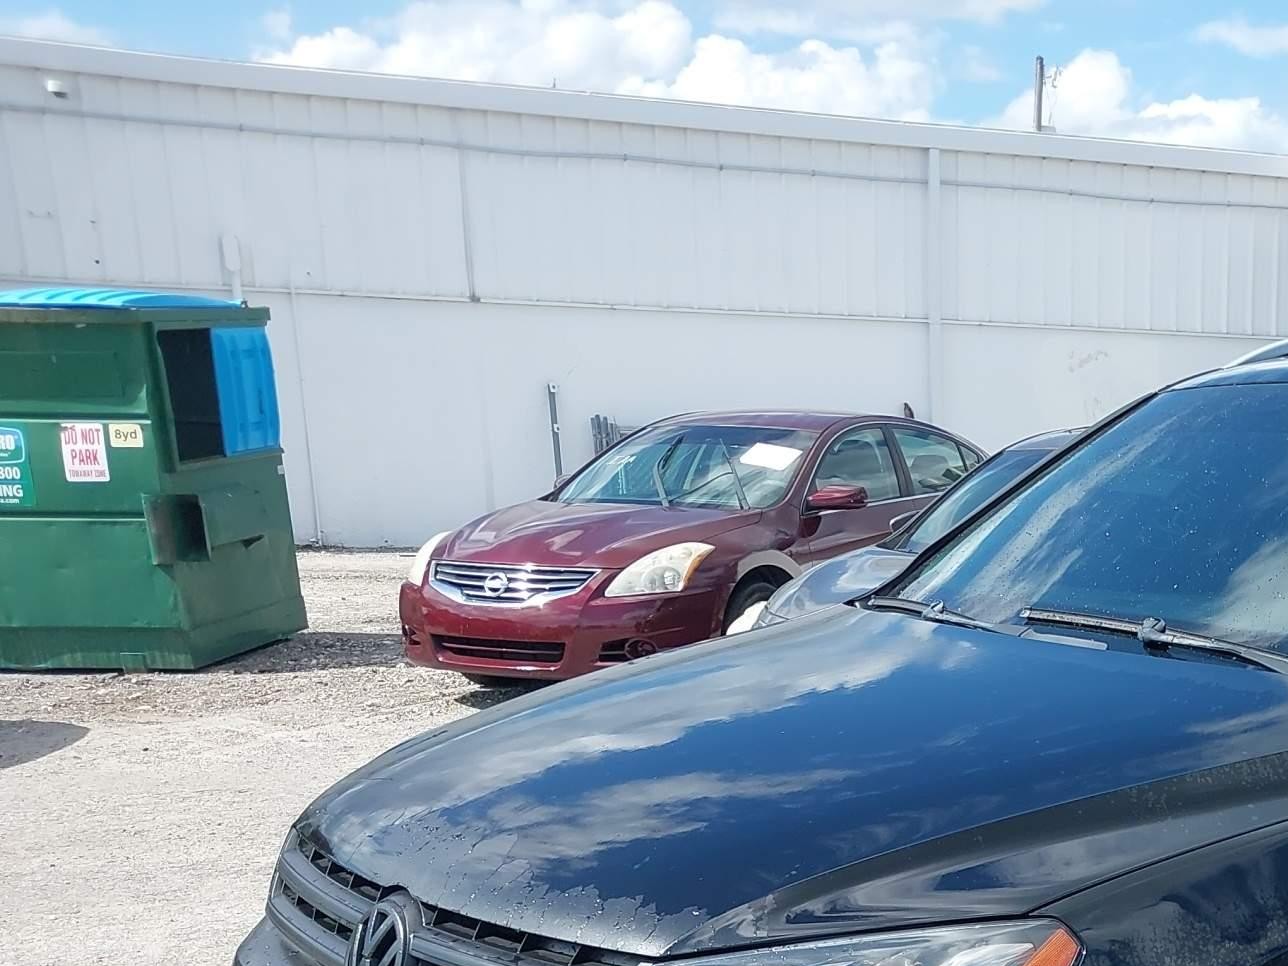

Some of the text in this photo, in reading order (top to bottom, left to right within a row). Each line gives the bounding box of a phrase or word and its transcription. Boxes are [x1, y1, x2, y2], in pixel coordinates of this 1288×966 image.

[64, 427, 101, 446] DO NOT
[114, 429, 138, 441] 8yd
[70, 448, 101, 466] PARK
